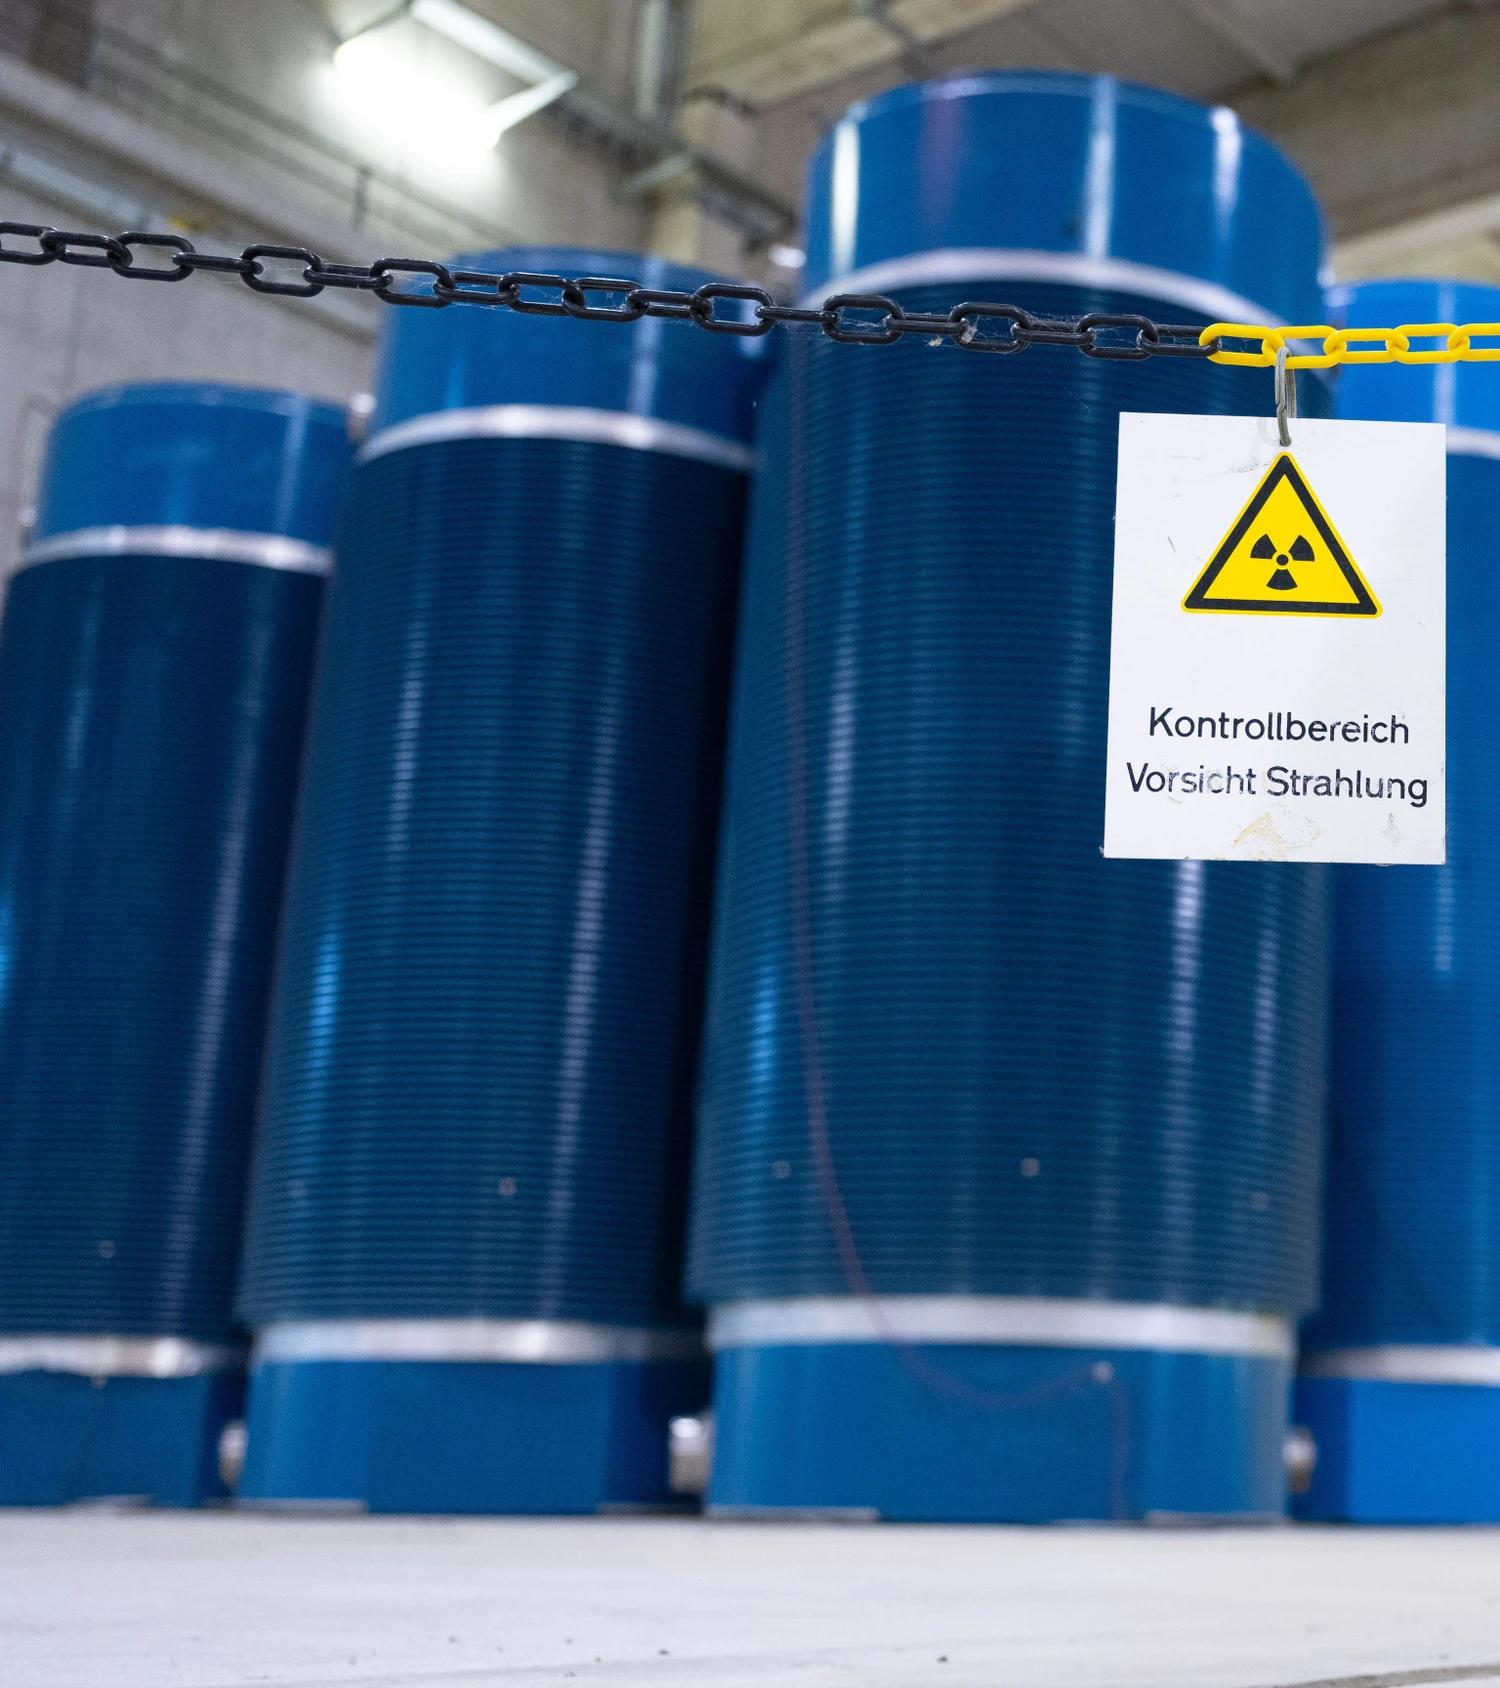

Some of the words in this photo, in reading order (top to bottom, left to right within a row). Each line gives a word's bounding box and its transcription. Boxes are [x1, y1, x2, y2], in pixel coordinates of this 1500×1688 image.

[1149, 706, 1410, 744] Kontrollbereich
[1126, 762, 1257, 795] Vorsicht
[1266, 765, 1429, 808] Strahlung
